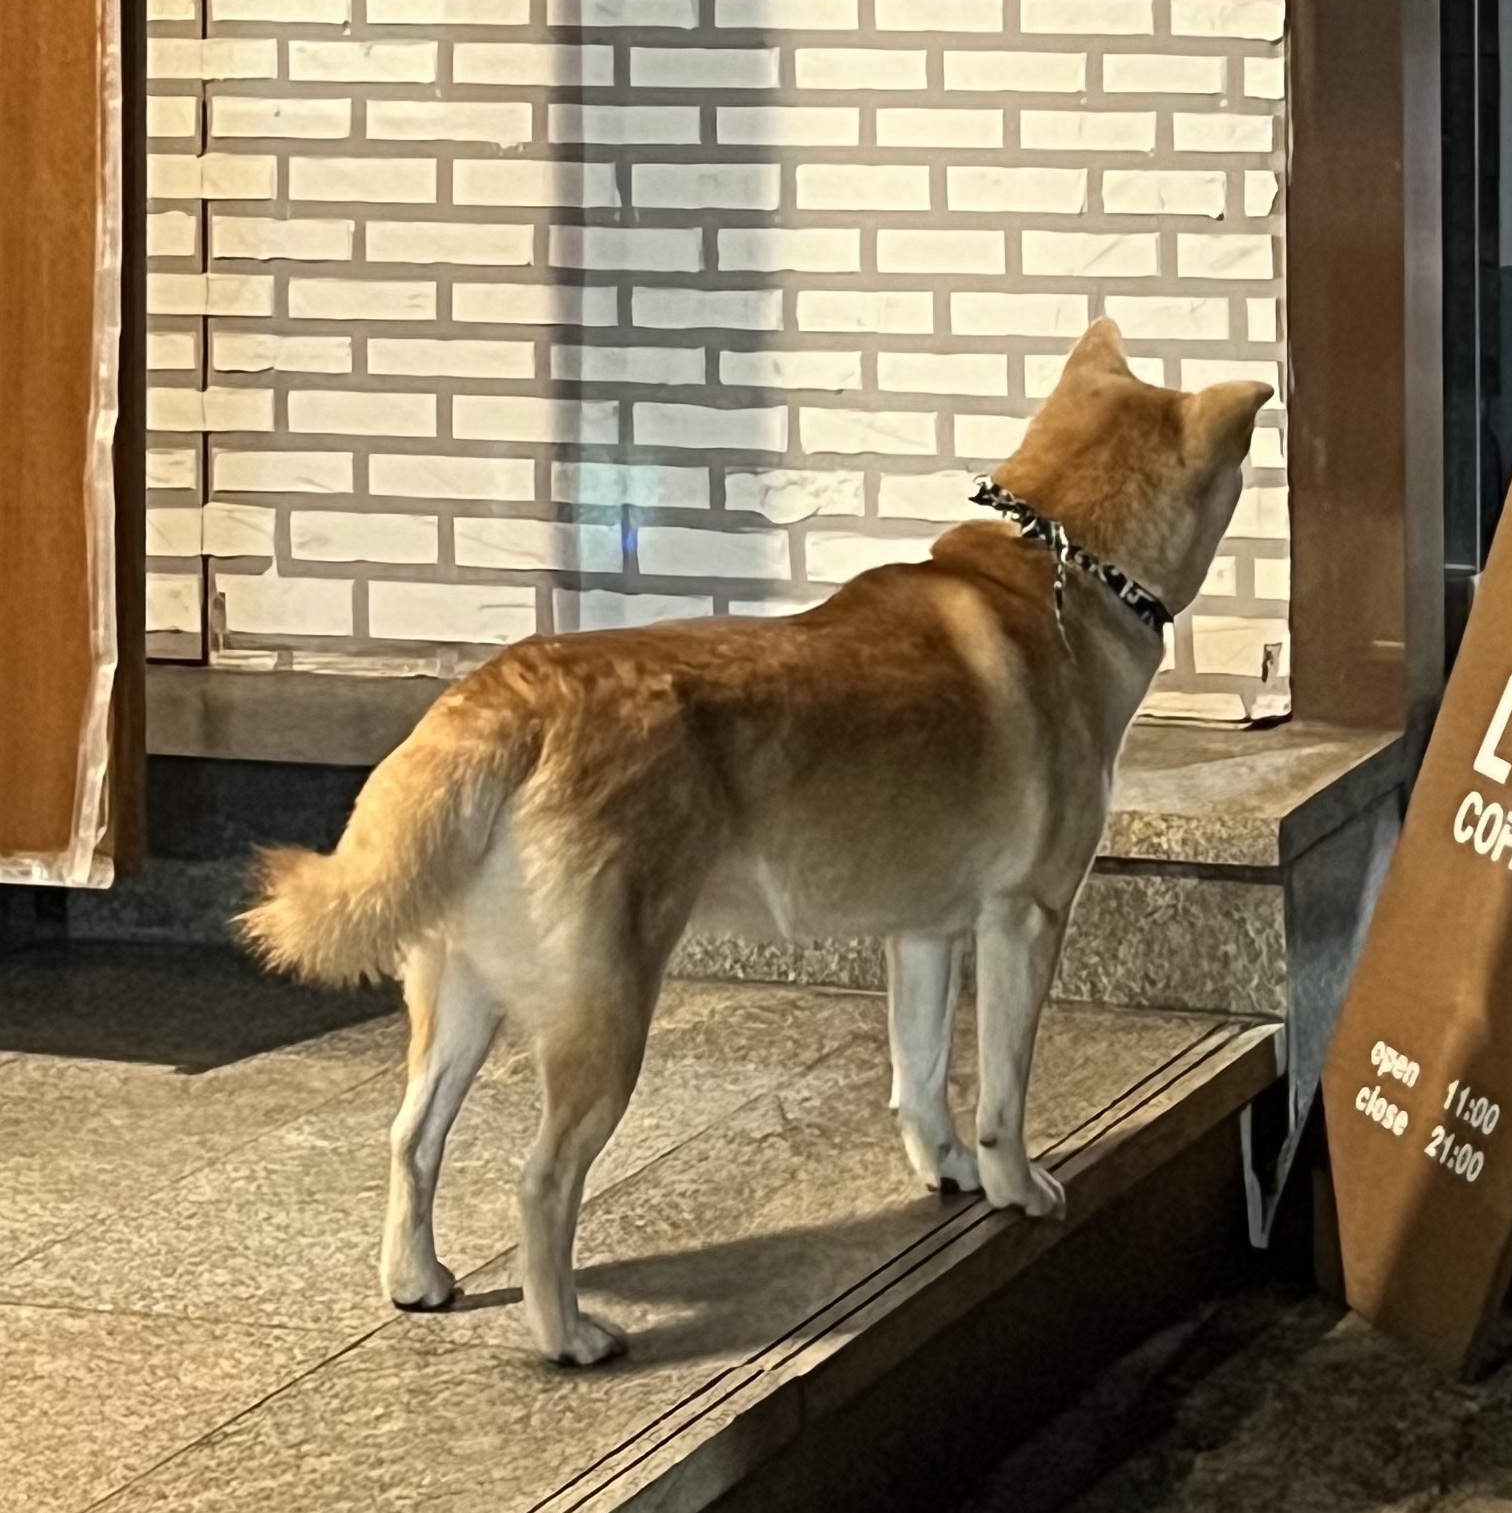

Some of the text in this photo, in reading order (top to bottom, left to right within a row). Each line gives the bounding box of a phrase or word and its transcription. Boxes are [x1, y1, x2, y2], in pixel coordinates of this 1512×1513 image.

[1354, 1085, 1485, 1183] close 21:00
[1370, 1040, 1501, 1136] open 11:00
